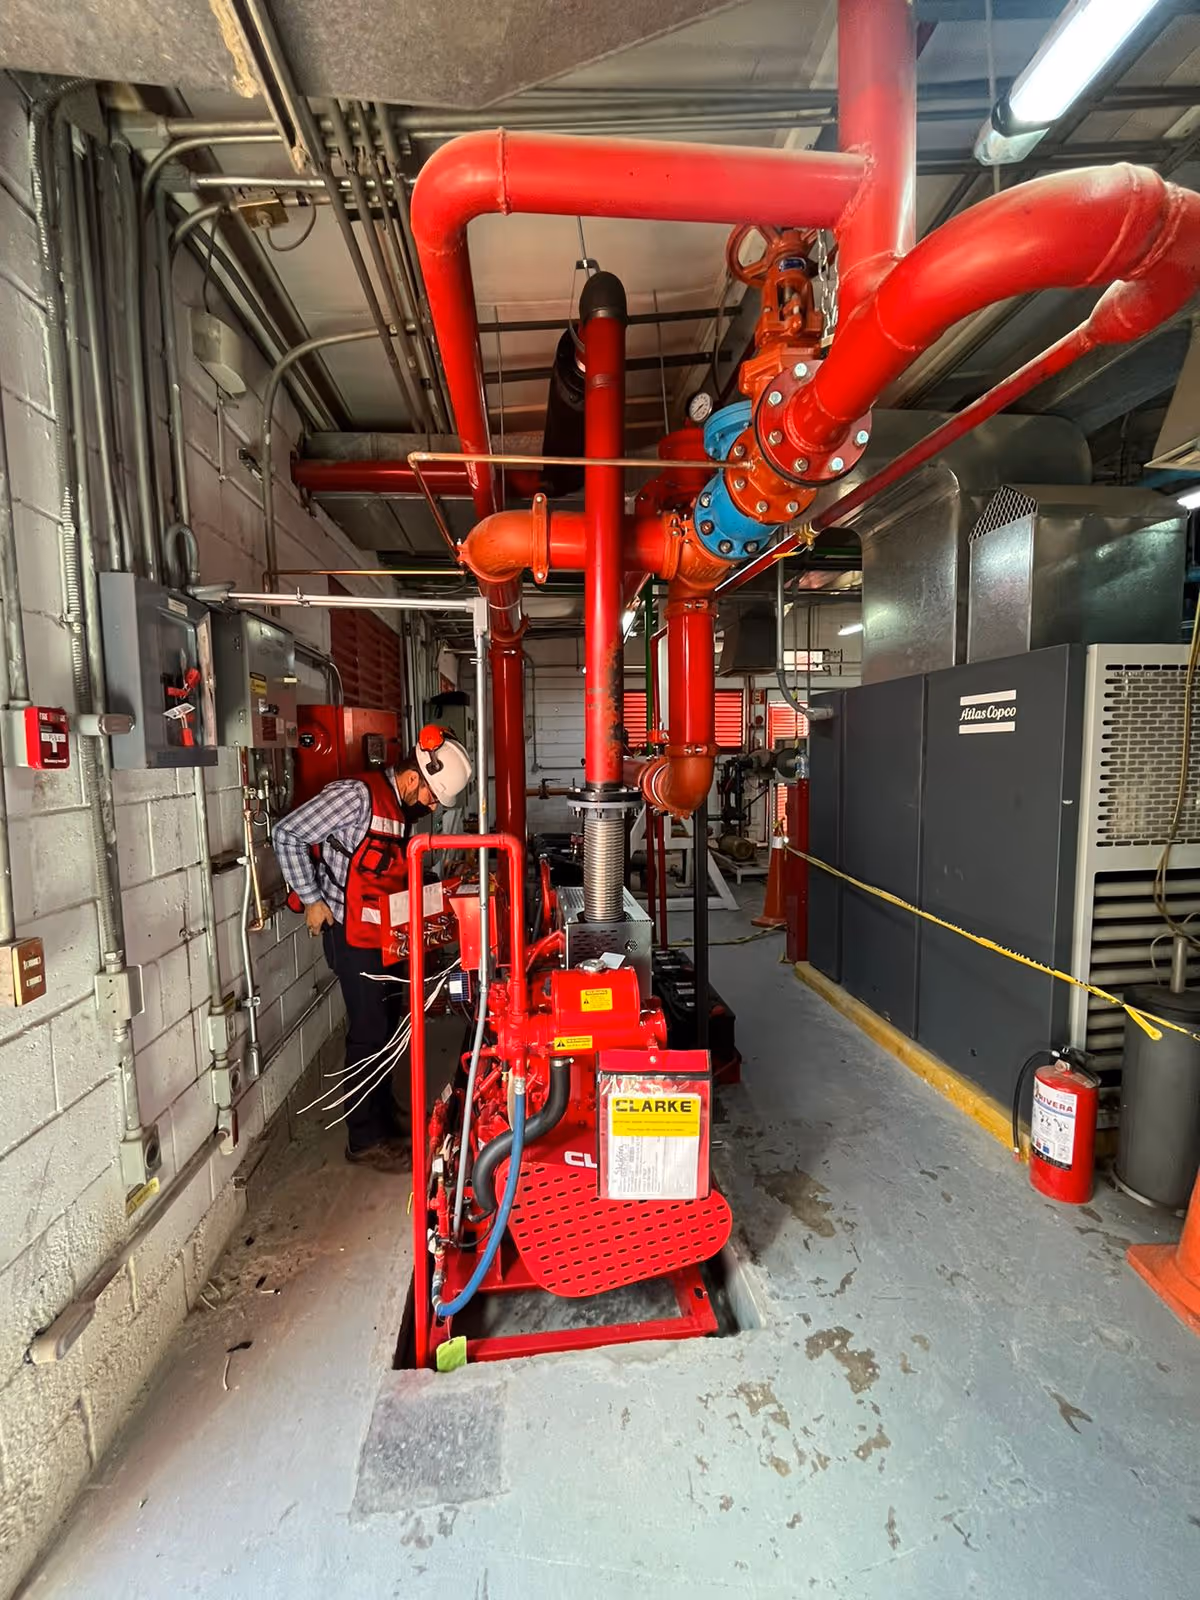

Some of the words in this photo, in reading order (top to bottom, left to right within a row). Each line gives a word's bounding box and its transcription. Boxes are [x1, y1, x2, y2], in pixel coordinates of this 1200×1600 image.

[960, 707, 987, 721] Atlas
[987, 705, 1017, 721] Copco
[615, 1099, 692, 1113] CLARKE
[1038, 1094, 1073, 1113] RIVERA
